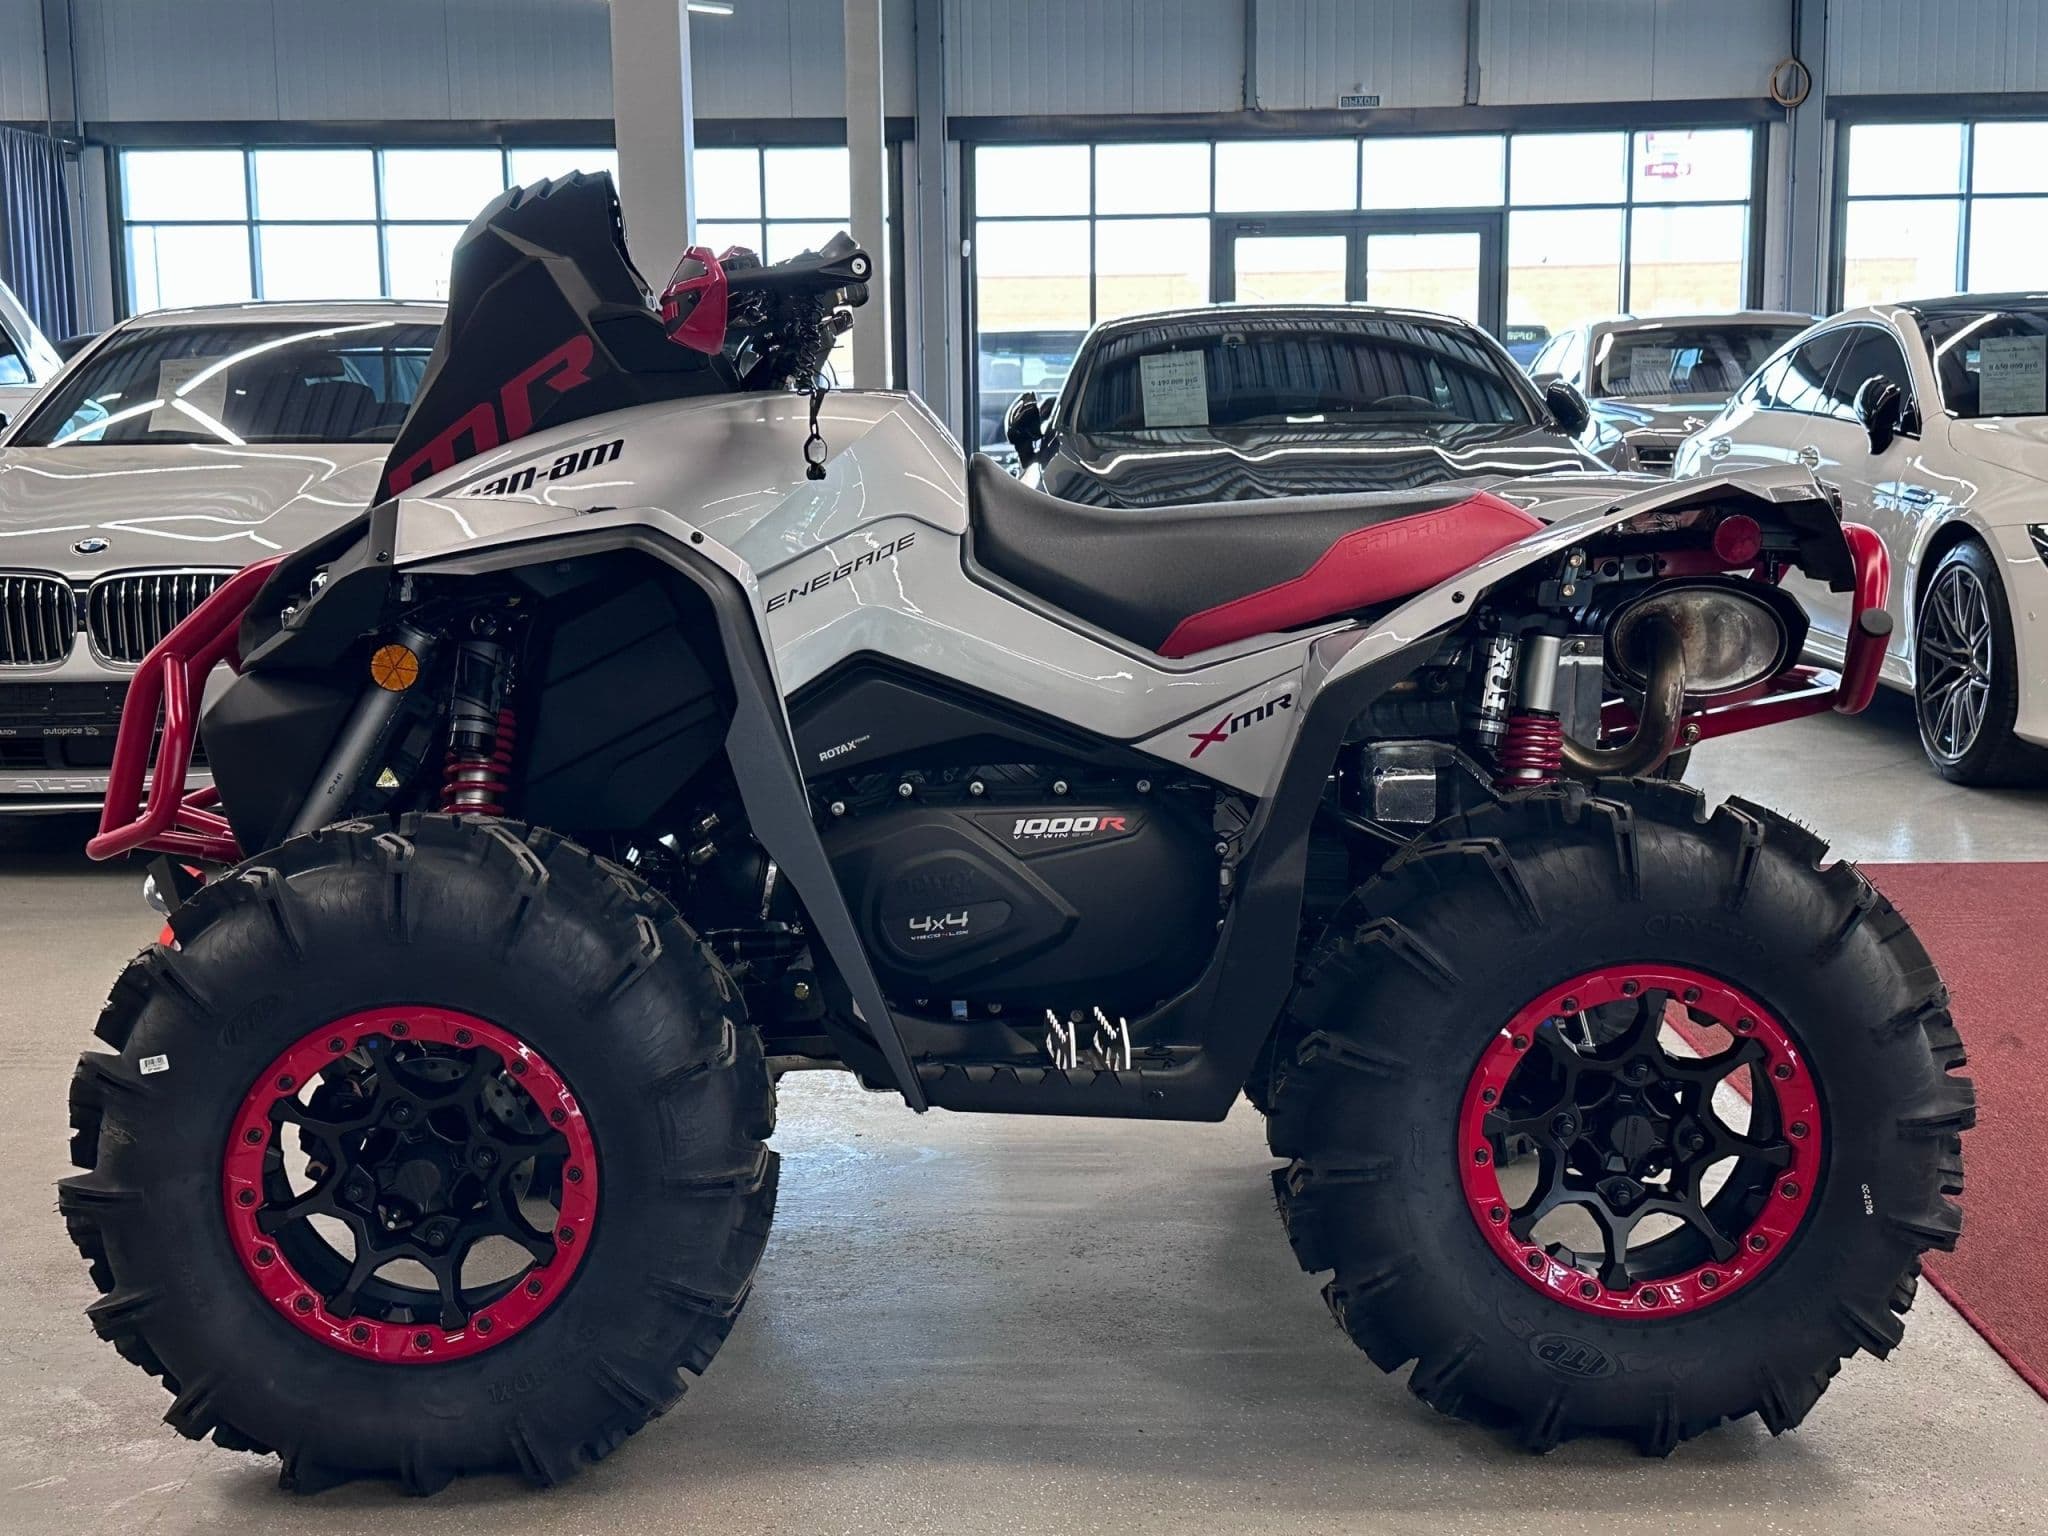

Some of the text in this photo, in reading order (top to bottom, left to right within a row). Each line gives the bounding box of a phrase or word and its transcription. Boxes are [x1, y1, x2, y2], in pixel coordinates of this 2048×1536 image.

[43, 727, 83, 737] autoprice
[819, 740, 857, 762] ROTAX
[1013, 816, 1126, 835] 1000R
[1537, 1342, 1609, 1376] ITP
